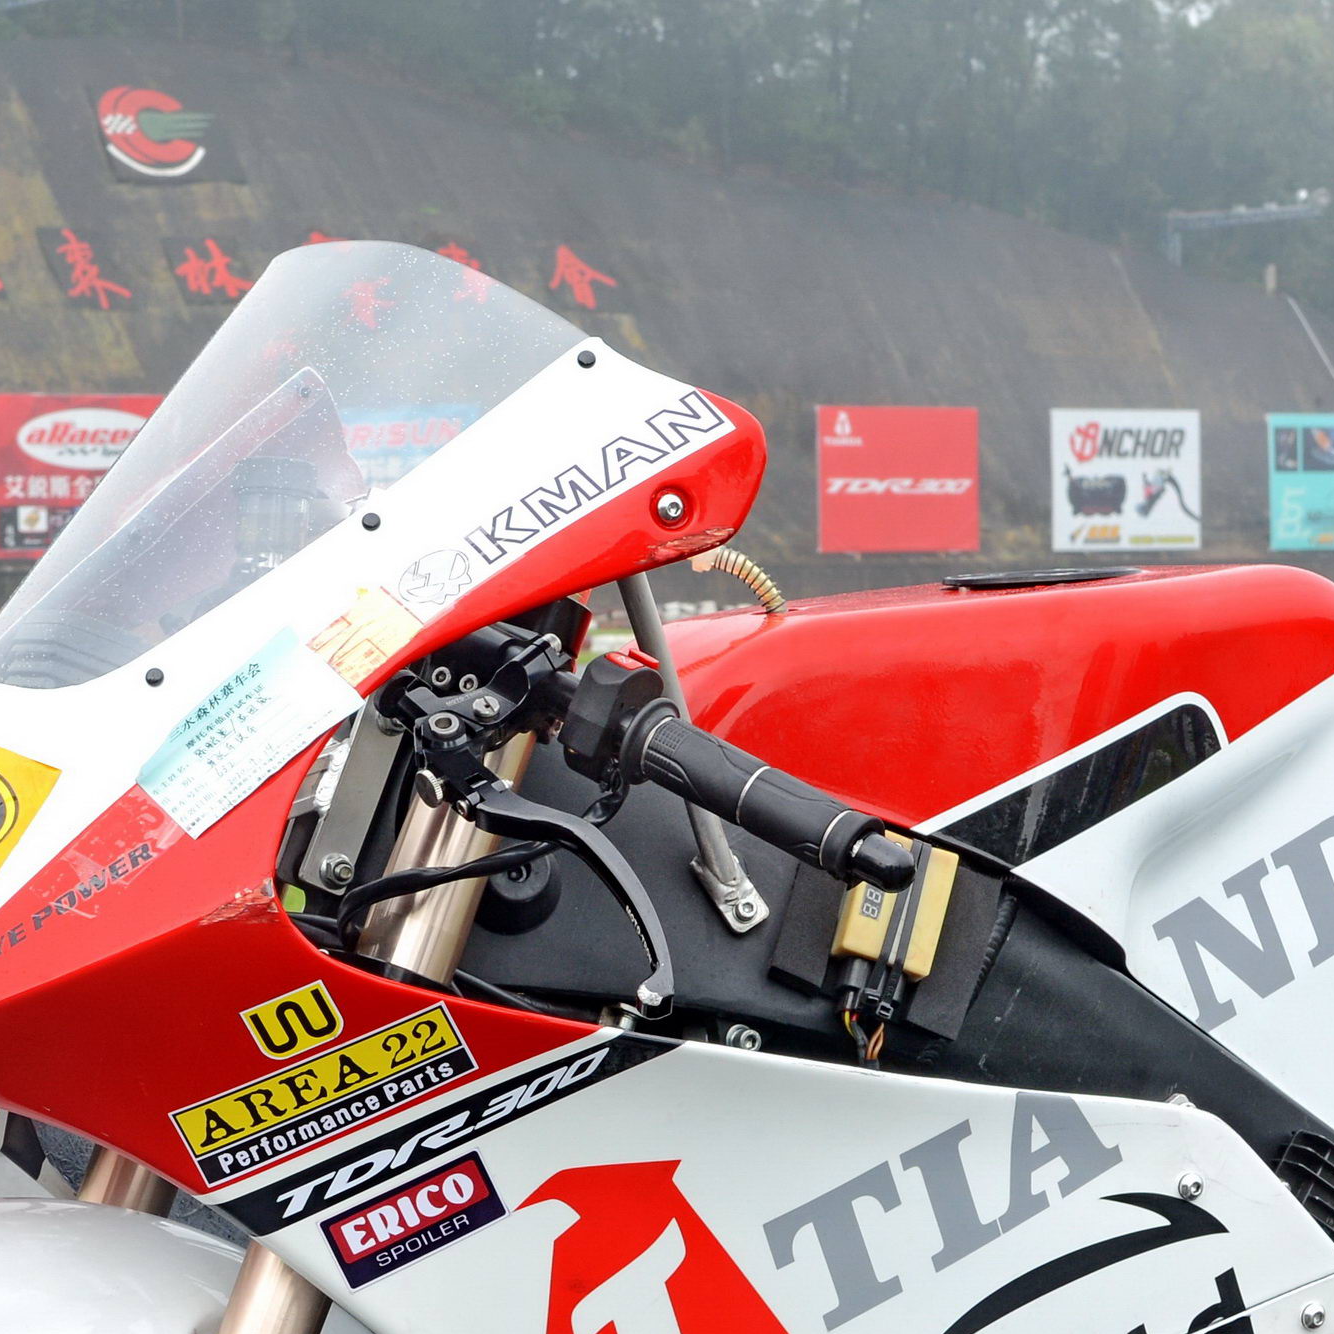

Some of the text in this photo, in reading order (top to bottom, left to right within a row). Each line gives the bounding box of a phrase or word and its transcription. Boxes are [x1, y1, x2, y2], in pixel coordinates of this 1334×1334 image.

[466, 391, 727, 564] KMAN
[169, 663, 261, 743] 三水森林赛车会
[31, 842, 155, 930] POWER
[199, 1019, 446, 1147] AREA 22
[218, 1060, 455, 1174] Performance Parts
[340, 1170, 476, 1255] ERICO
[375, 1213, 470, 1267] SPOILER
[762, 1091, 1123, 1331] TIA
